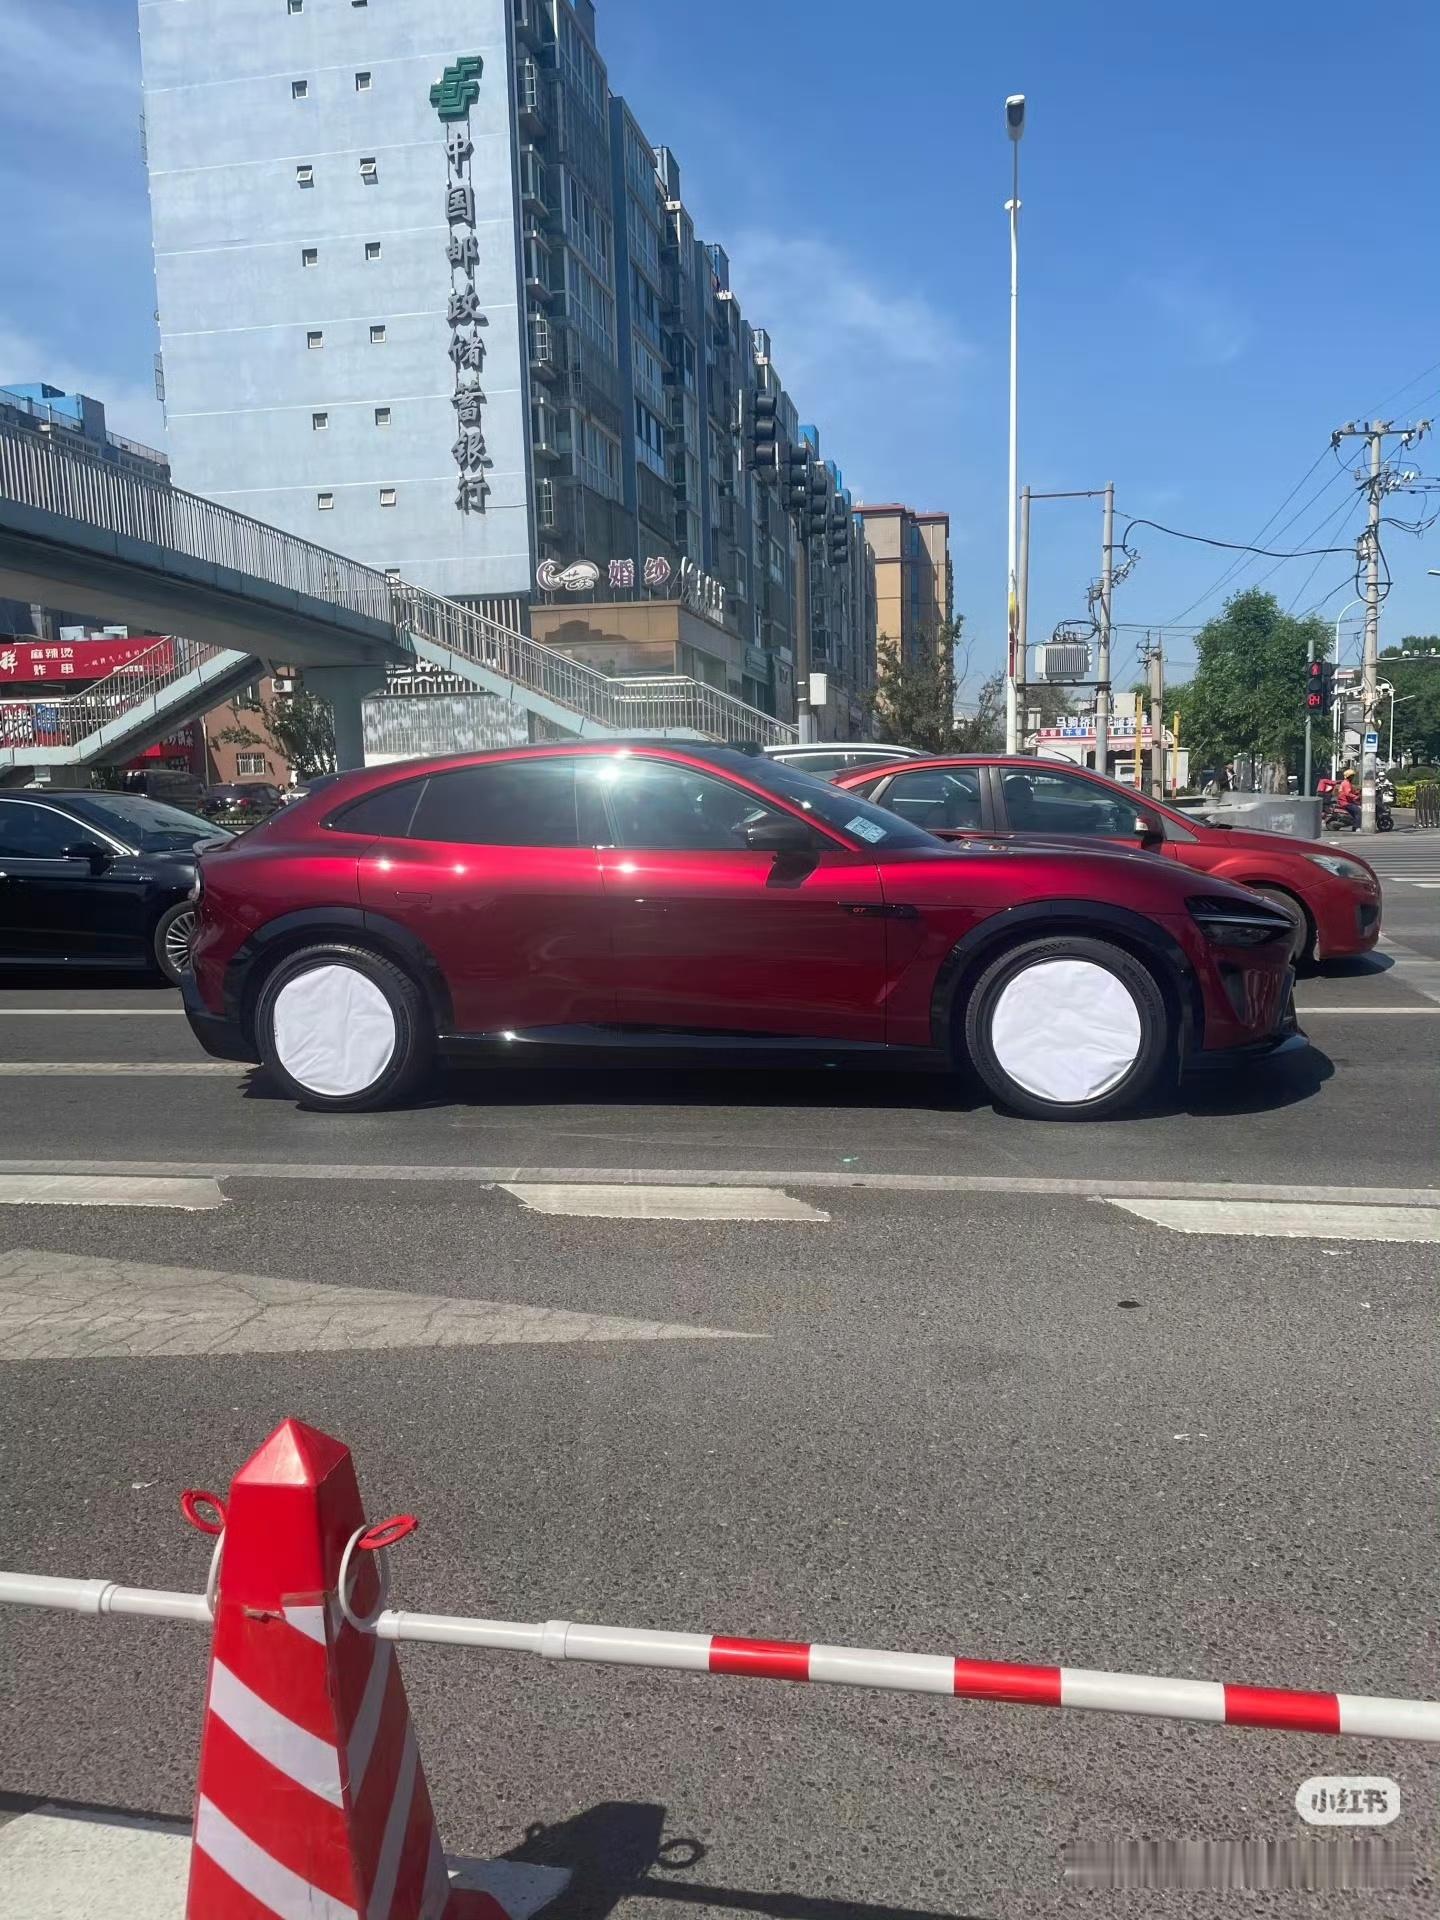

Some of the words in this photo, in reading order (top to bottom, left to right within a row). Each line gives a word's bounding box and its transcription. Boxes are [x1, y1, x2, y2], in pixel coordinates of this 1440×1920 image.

[444, 133, 493, 515] 中国邮政储蓄银行
[608, 556, 671, 589] 婚纱
[31, 647, 74, 659] 麻辣烫
[33, 663, 74, 676] 炸串
